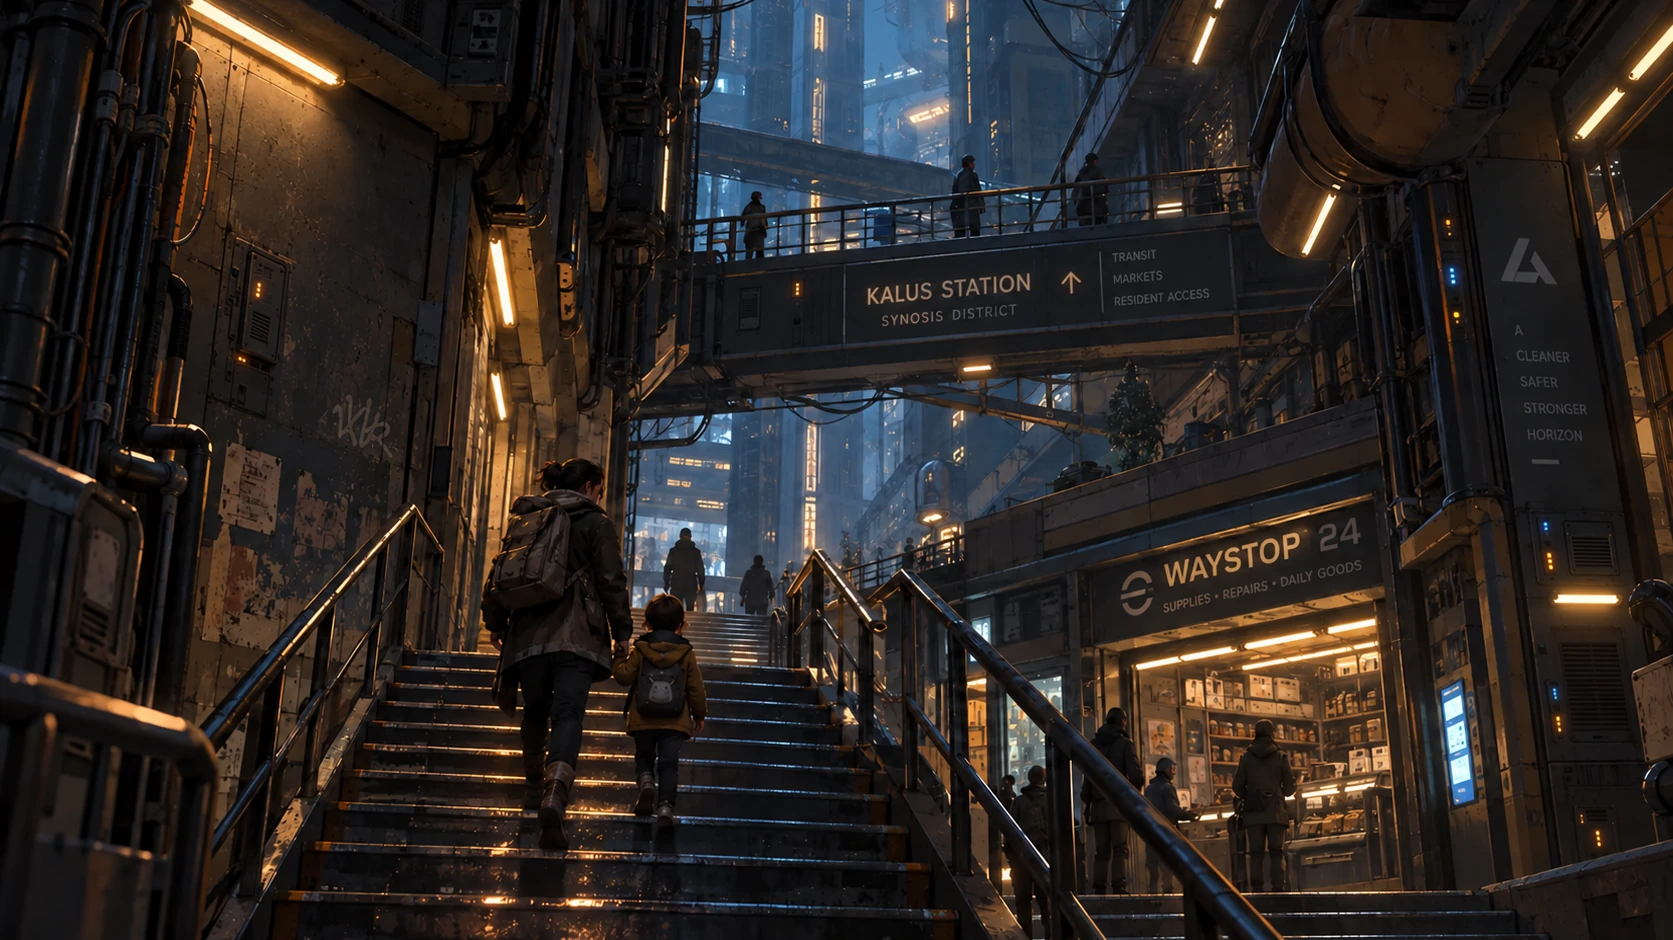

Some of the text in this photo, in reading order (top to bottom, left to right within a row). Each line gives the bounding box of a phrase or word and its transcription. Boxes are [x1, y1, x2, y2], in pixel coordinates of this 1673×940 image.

[1112, 249, 1157, 263] TRANSIT
[1113, 270, 1163, 285] MARKETS
[866, 272, 1031, 306] KALUS STATION
[1113, 287, 1210, 307] RESIDENT ACCESS
[881, 303, 1017, 327] SYNOSIS DISTRICT
[1514, 324, 1524, 336] A
[1516, 350, 1570, 363] CLEANER
[1520, 376, 1559, 389] SAFER
[1523, 402, 1588, 415] STRONGER
[1527, 429, 1583, 442] HORIZON
[1163, 517, 1362, 587] WAYSTOP 24
[1163, 559, 1363, 613] SUPPLIES REPAIRS DAILY GOODS
